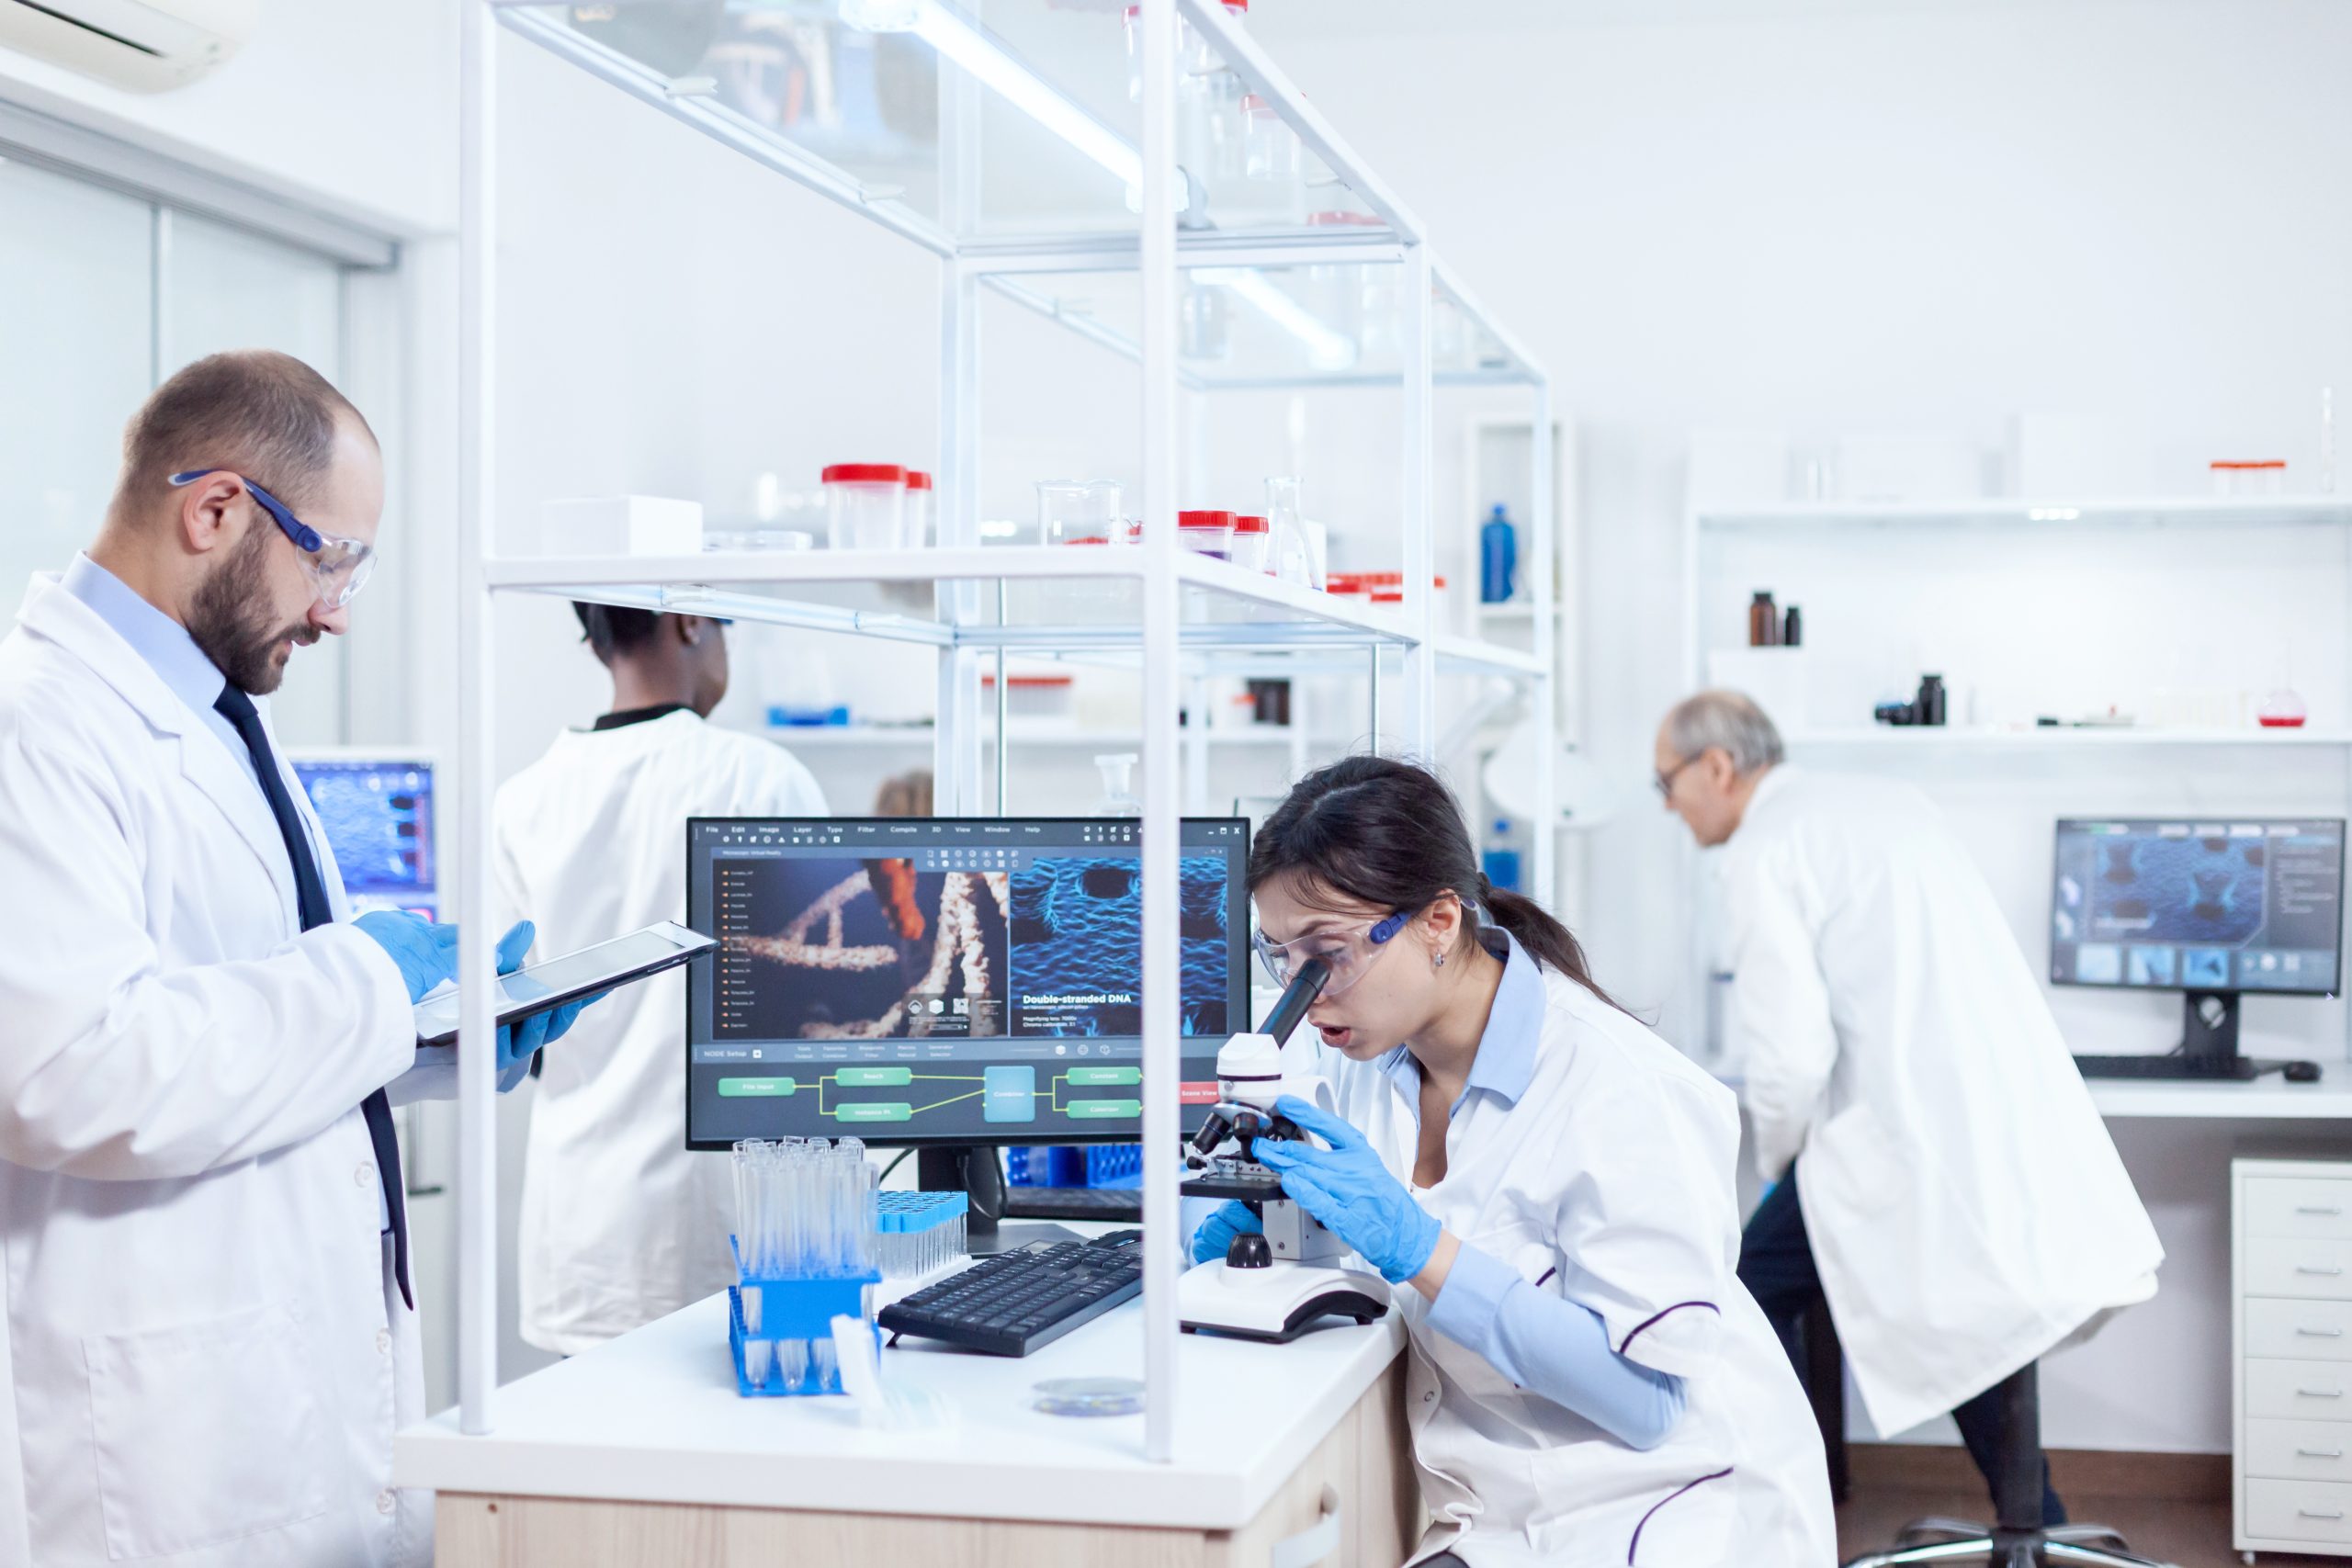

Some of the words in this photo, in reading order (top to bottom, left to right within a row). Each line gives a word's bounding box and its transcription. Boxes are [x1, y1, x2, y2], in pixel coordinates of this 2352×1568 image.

[758, 827, 780, 835] Image
[793, 827, 812, 835] Layer
[827, 826, 843, 834] Type
[889, 826, 918, 834] Compile
[1023, 994, 1106, 1004] Double-stranded
[1107, 994, 1132, 1004] DNA
[726, 1050, 747, 1058] Setup
